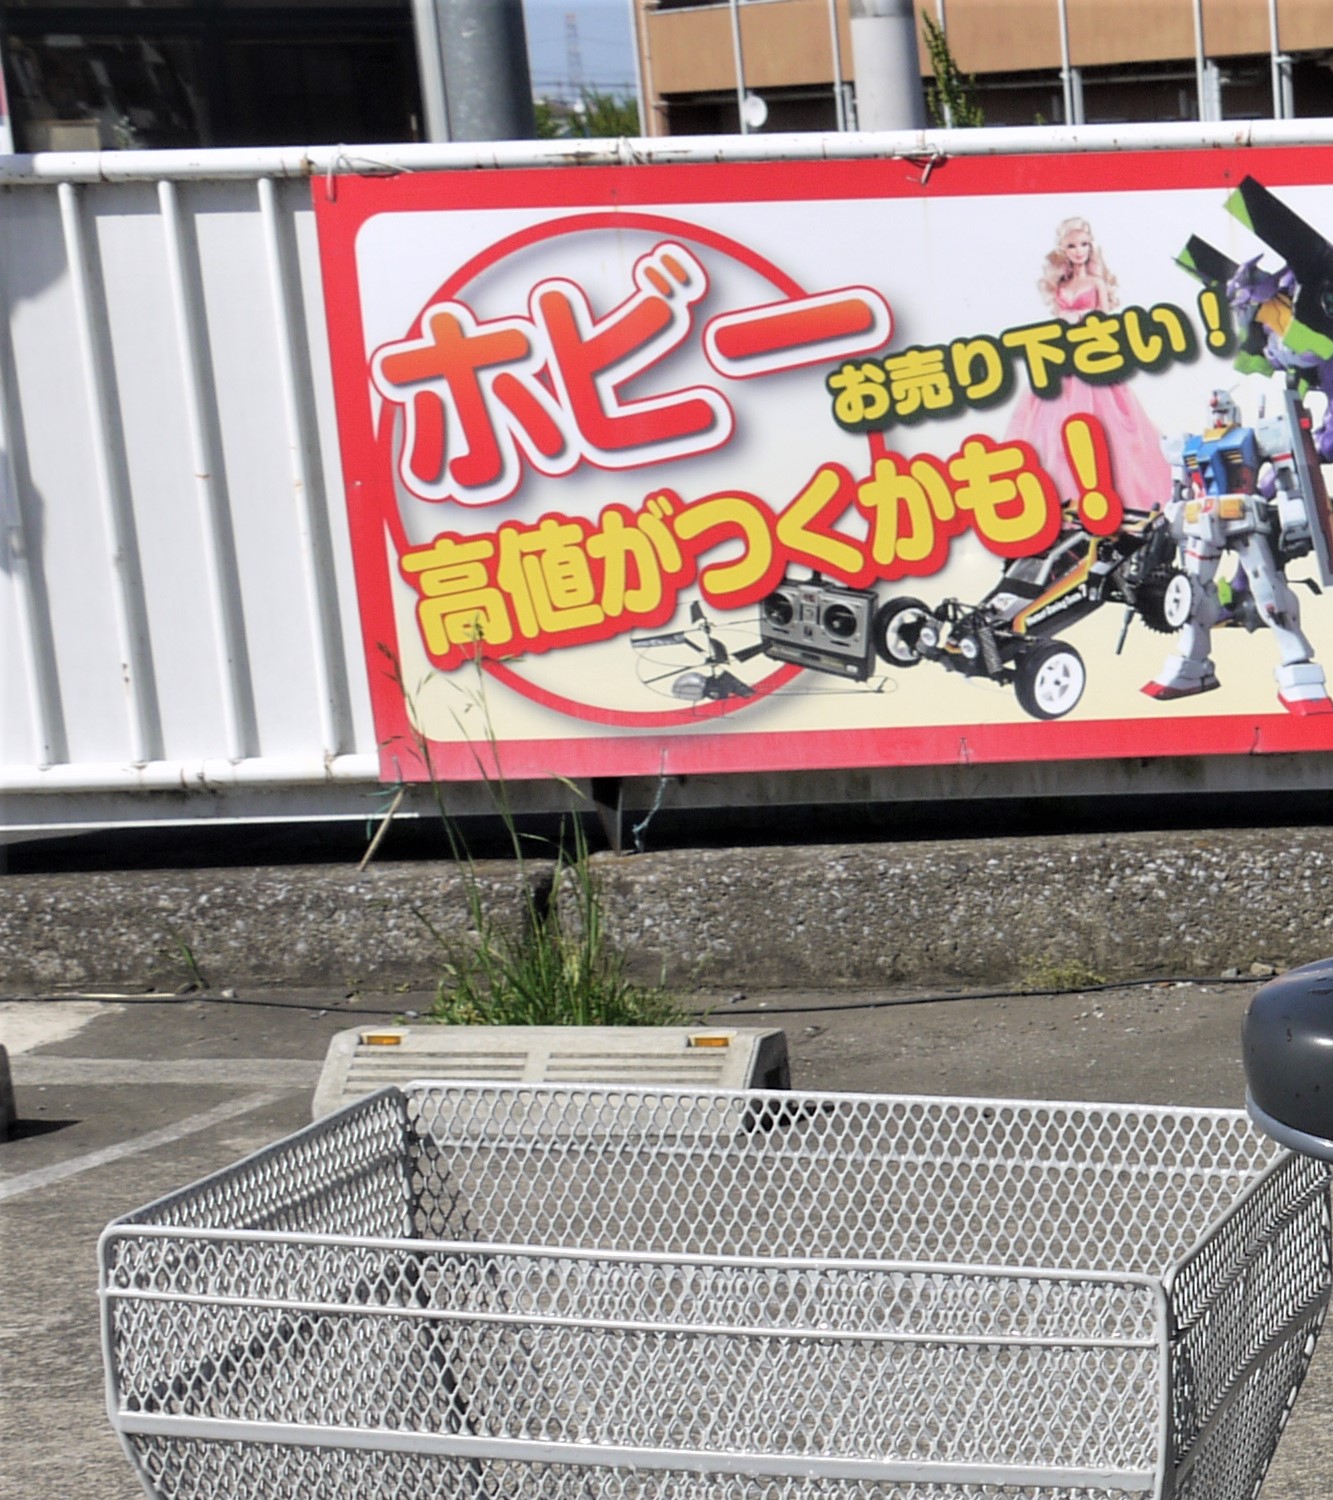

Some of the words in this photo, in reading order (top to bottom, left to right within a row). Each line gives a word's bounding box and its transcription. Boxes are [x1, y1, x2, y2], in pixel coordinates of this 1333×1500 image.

[374, 246, 886, 498] ホビー
[826, 288, 1230, 428] お売り下さい！
[400, 417, 1110, 658] 高値がつくかも！
